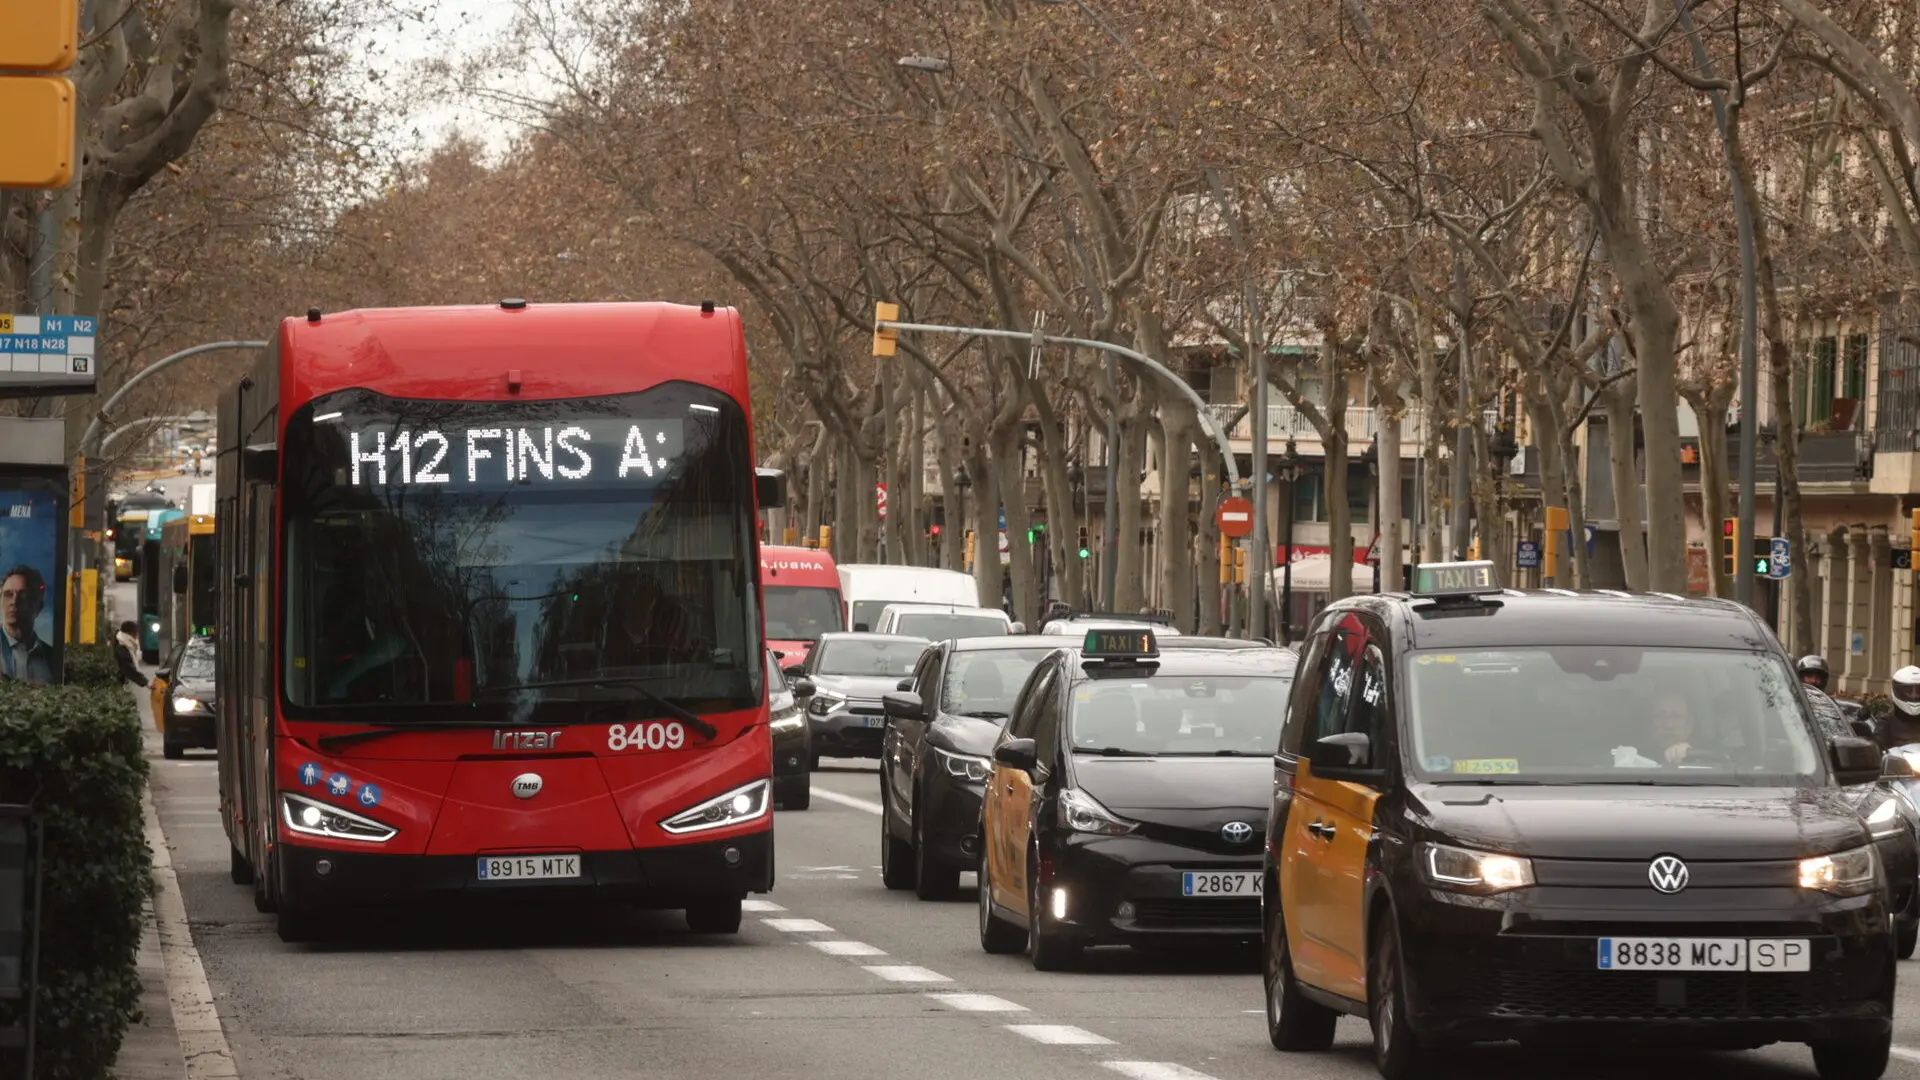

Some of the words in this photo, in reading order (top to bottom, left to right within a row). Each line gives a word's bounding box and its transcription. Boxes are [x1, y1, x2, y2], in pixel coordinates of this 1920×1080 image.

[47, 320, 63, 331] N1
[73, 320, 92, 332] N2
[14, 338, 38, 350] N18
[42, 338, 65, 350] N28
[351, 430, 449, 485] H12
[467, 426, 592, 482] FINS
[618, 425, 667, 478] A:
[1436, 568, 1471, 589] TAXI
[1101, 635, 1132, 651] TAXI
[1142, 634, 1149, 653] 1
[492, 729, 562, 750] irizar
[608, 722, 685, 751] 8409
[517, 782, 539, 790] TMB
[491, 859, 536, 876] 8915
[543, 858, 575, 876] MTK
[1197, 875, 1246, 893] 2867
[1252, 875, 1263, 893] K
[1617, 942, 1682, 966] 8838
[1691, 942, 1739, 966] MCJ
